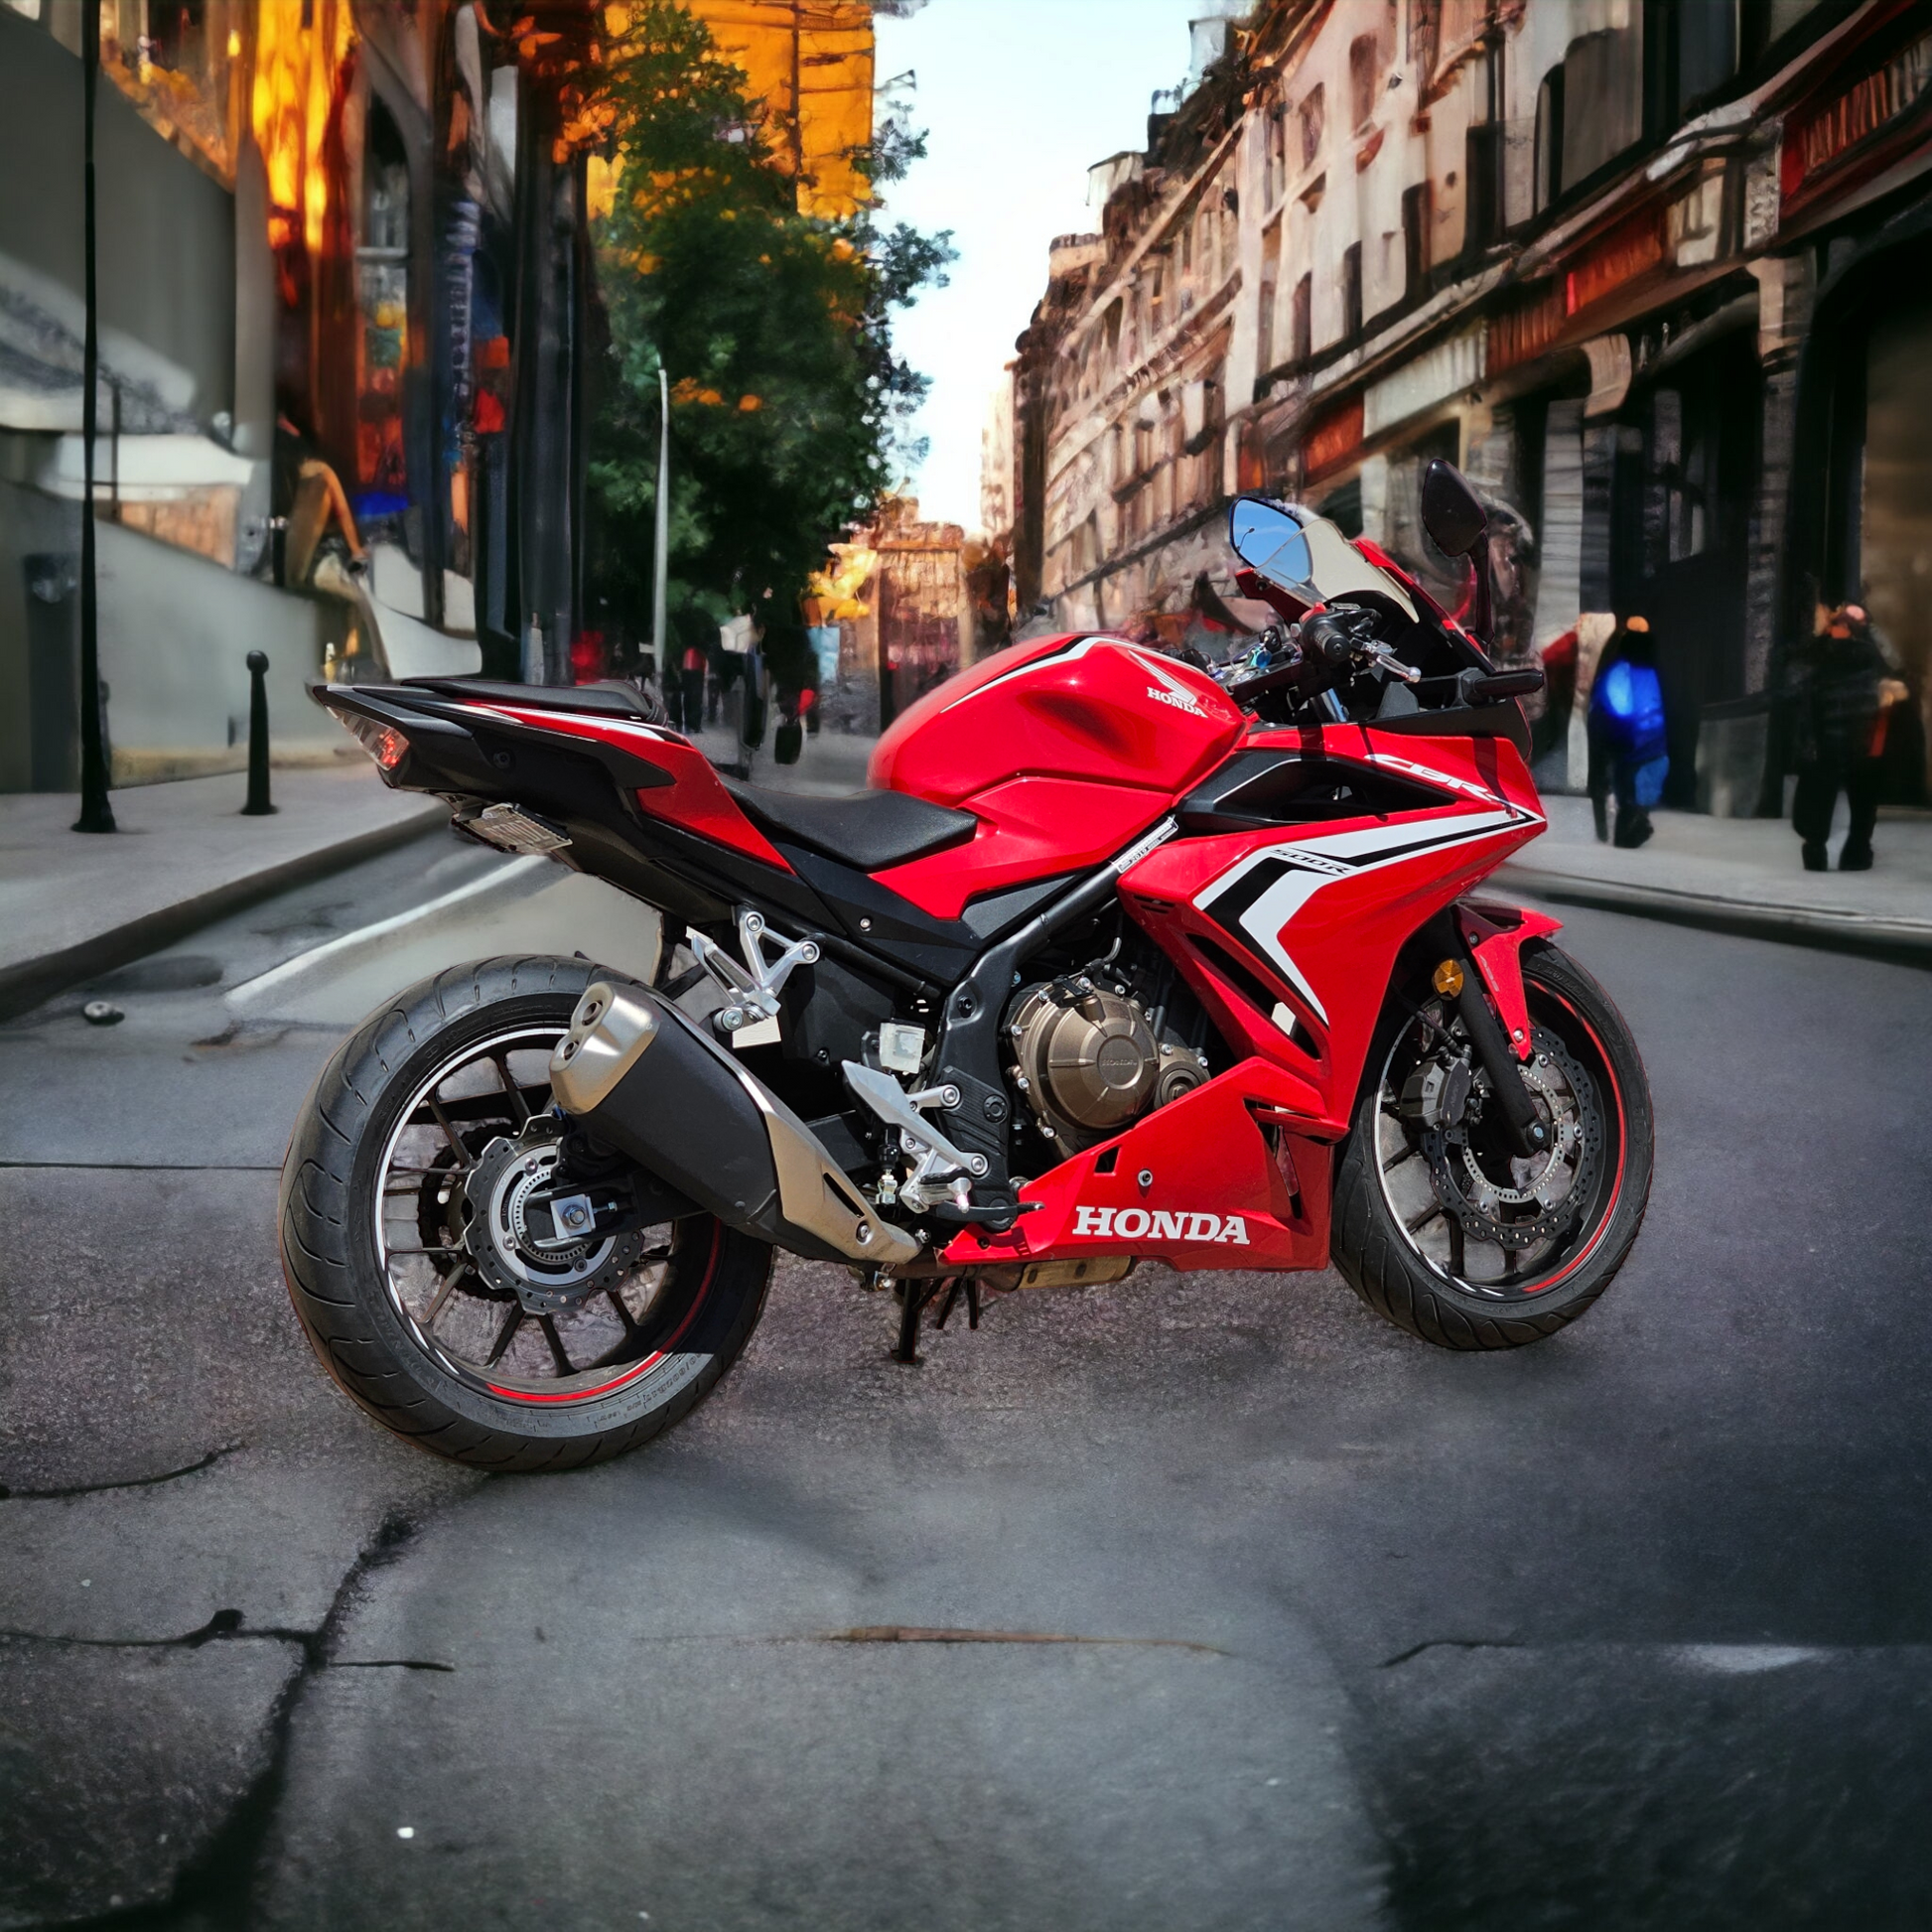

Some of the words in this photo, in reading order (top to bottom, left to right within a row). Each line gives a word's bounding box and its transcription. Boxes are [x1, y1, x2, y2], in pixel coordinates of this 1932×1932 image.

[1147, 686, 1208, 718] HONDA
[1364, 754, 1491, 801] CBR
[1270, 849, 1351, 875] 500R
[1072, 1205, 1250, 1244] HONDA
